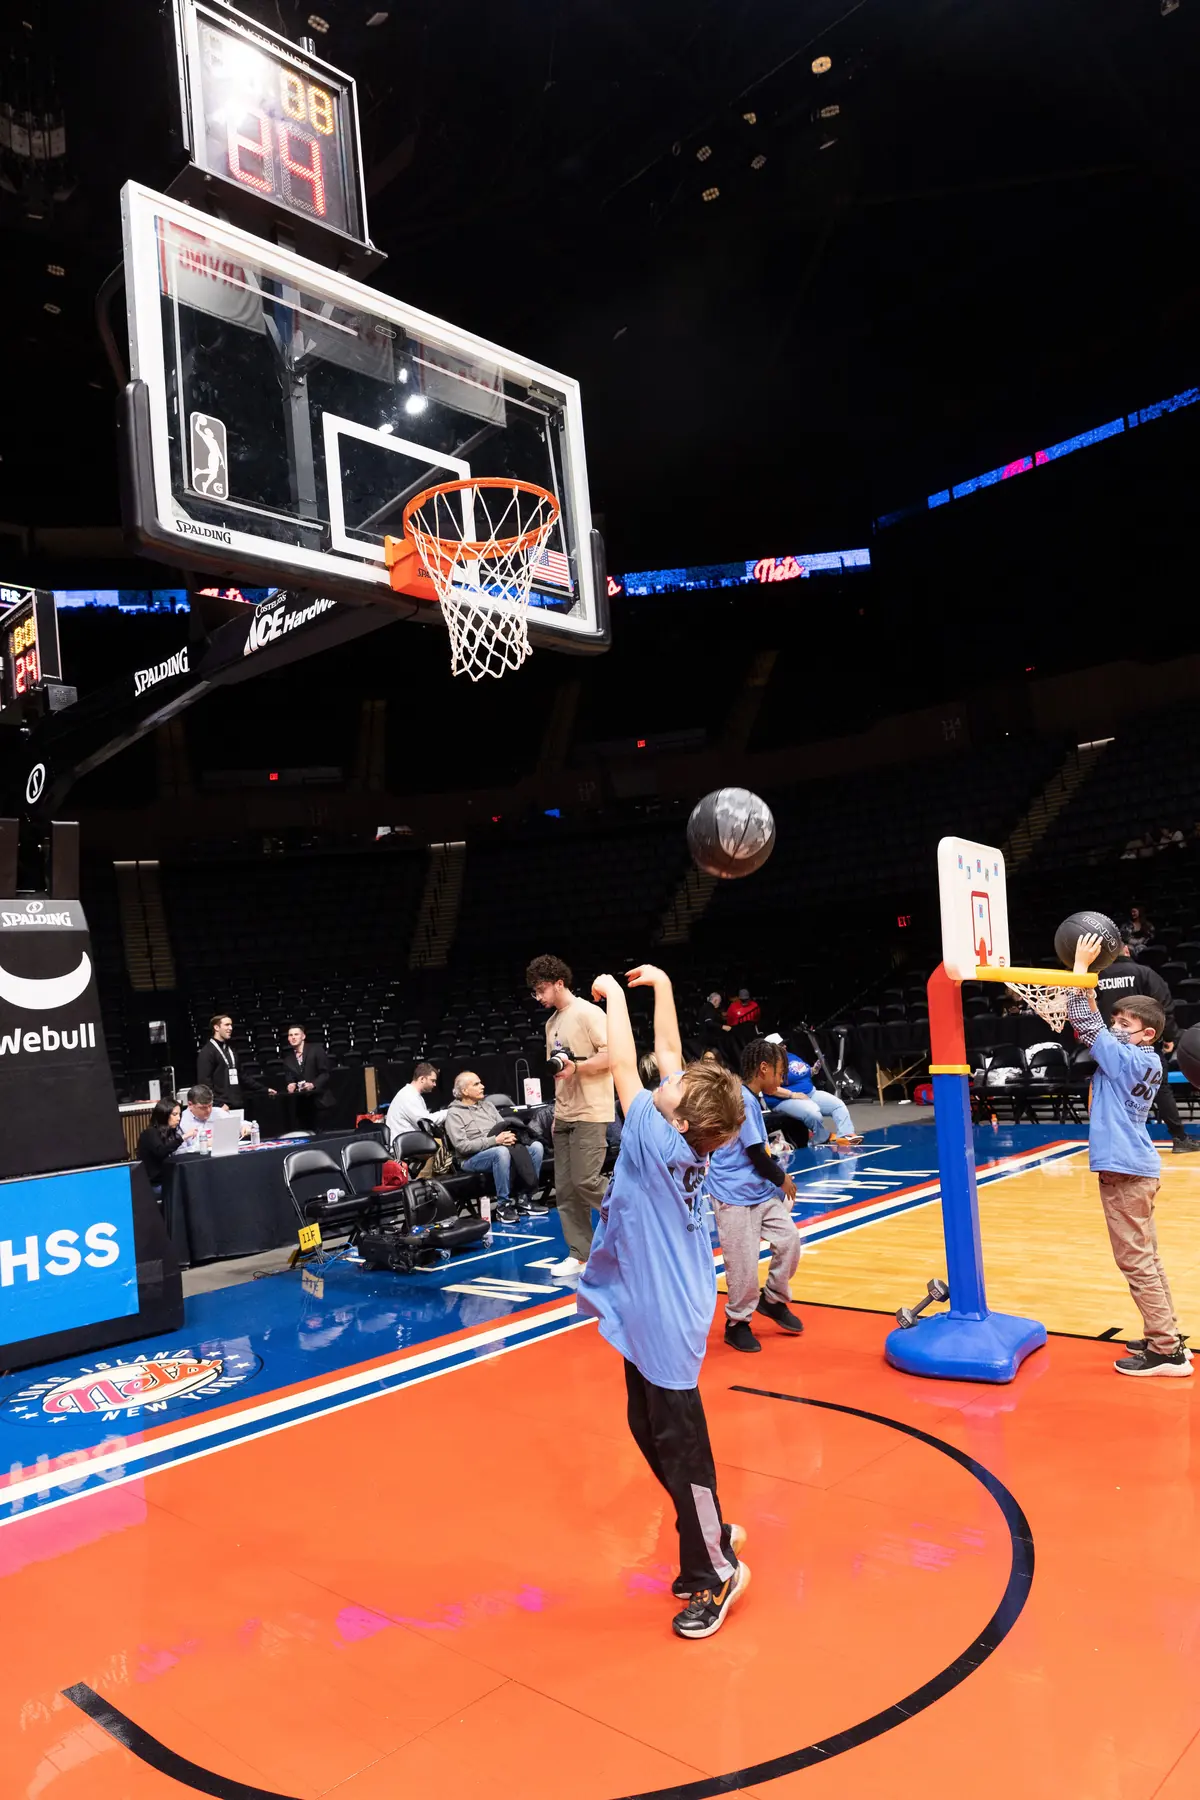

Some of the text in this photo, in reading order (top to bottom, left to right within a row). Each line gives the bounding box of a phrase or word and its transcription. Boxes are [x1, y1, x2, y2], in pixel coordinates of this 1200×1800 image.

[227, 105, 326, 217] 24
[176, 520, 232, 545] SPALDING
[243, 598, 338, 656] ACE Hardwa
[16, 649, 39, 694] 24
[134, 646, 190, 697] SPALDING
[2, 911, 73, 927] SPALDING
[1098, 975, 1135, 990] SECURITY
[0, 1022, 96, 1056] Webull
[0, 1221, 120, 1287] HSS
[9, 1349, 192, 1403] LONG ISLAND
[101, 1374, 247, 1422] NEW YORK
